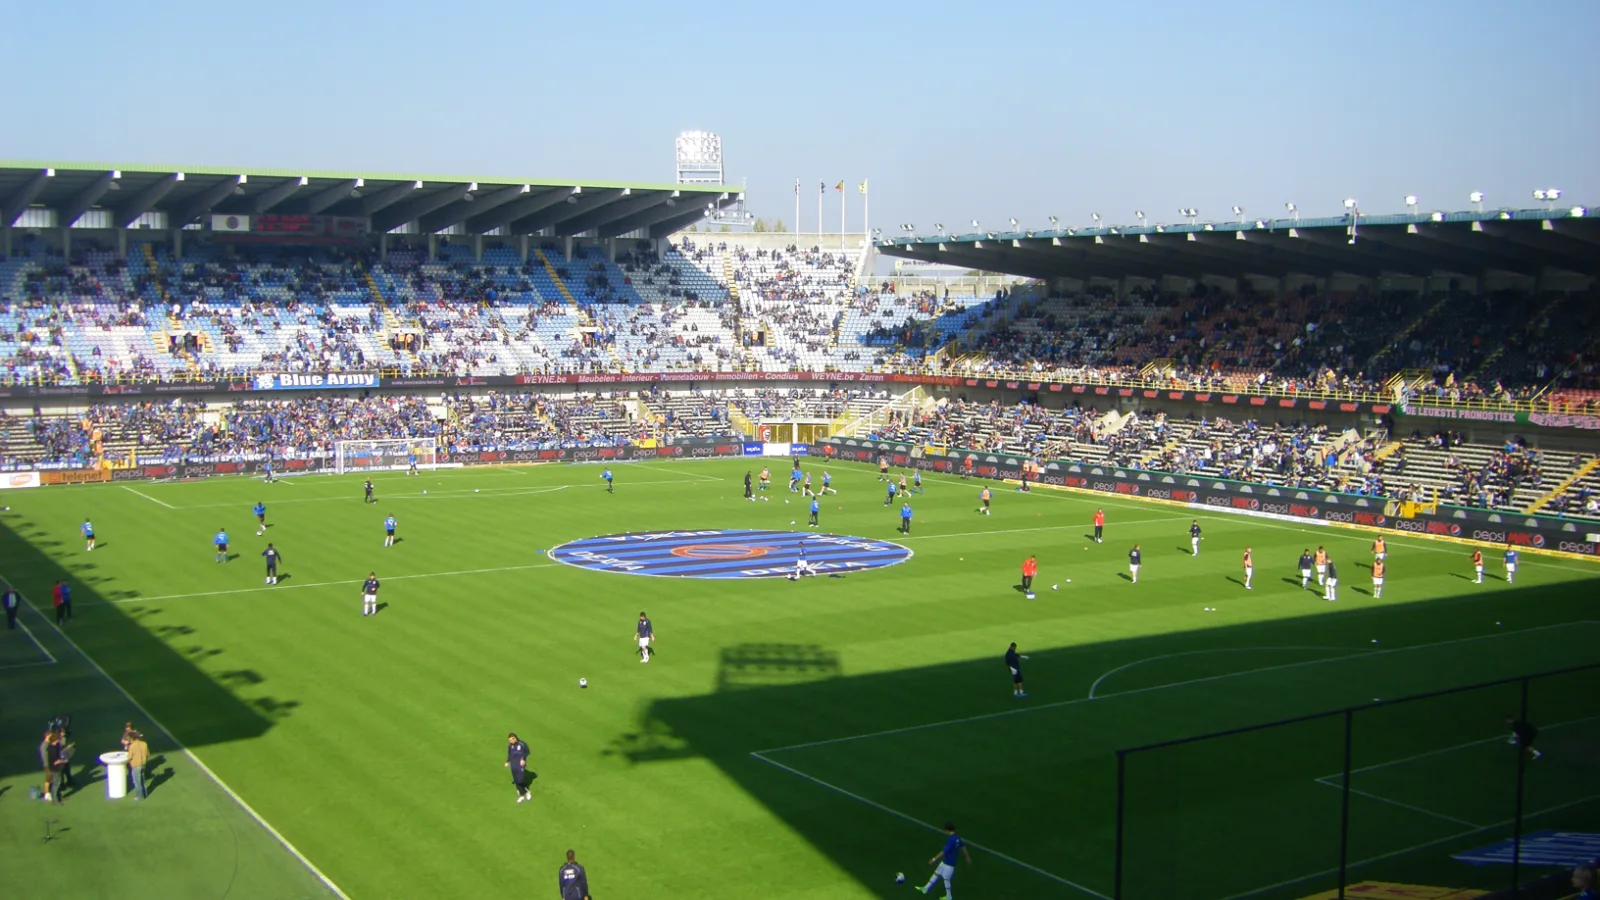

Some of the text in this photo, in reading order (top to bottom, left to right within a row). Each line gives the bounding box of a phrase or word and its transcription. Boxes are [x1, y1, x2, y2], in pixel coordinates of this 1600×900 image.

[280, 373, 374, 386] Blue Army
[523, 375, 567, 384] WEYNE.be
[578, 374, 615, 383] Meubelen
[622, 373, 653, 382] Interieur
[811, 372, 854, 381] WEYNE.be
[860, 374, 884, 382] Zarren
[1418, 407, 1457, 418] LEUKSTE
[1458, 409, 1516, 422] PRONOSTIEK
[513, 451, 538, 461] pepsi
[573, 449, 598, 459] pepsi
[633, 447, 657, 458] pepsi
[691, 446, 715, 456] pepsi
[453, 454, 479, 464] pepsi
[61, 469, 102, 480] telenet
[113, 469, 143, 480] pepsi
[184, 463, 213, 476] pepsi
[1000, 470, 1018, 480] pepsi
[1044, 475, 1065, 486] pepsi
[1094, 481, 1115, 493] pepsi
[1148, 488, 1171, 500] pepsi
[1207, 496, 1230, 507] pepsi
[1262, 502, 1288, 515] pepsi
[1325, 510, 1353, 523] pepsi
[1395, 519, 1425, 533] pepsi
[1473, 529, 1505, 543] pepsi
[1559, 540, 1595, 554] pepsi
